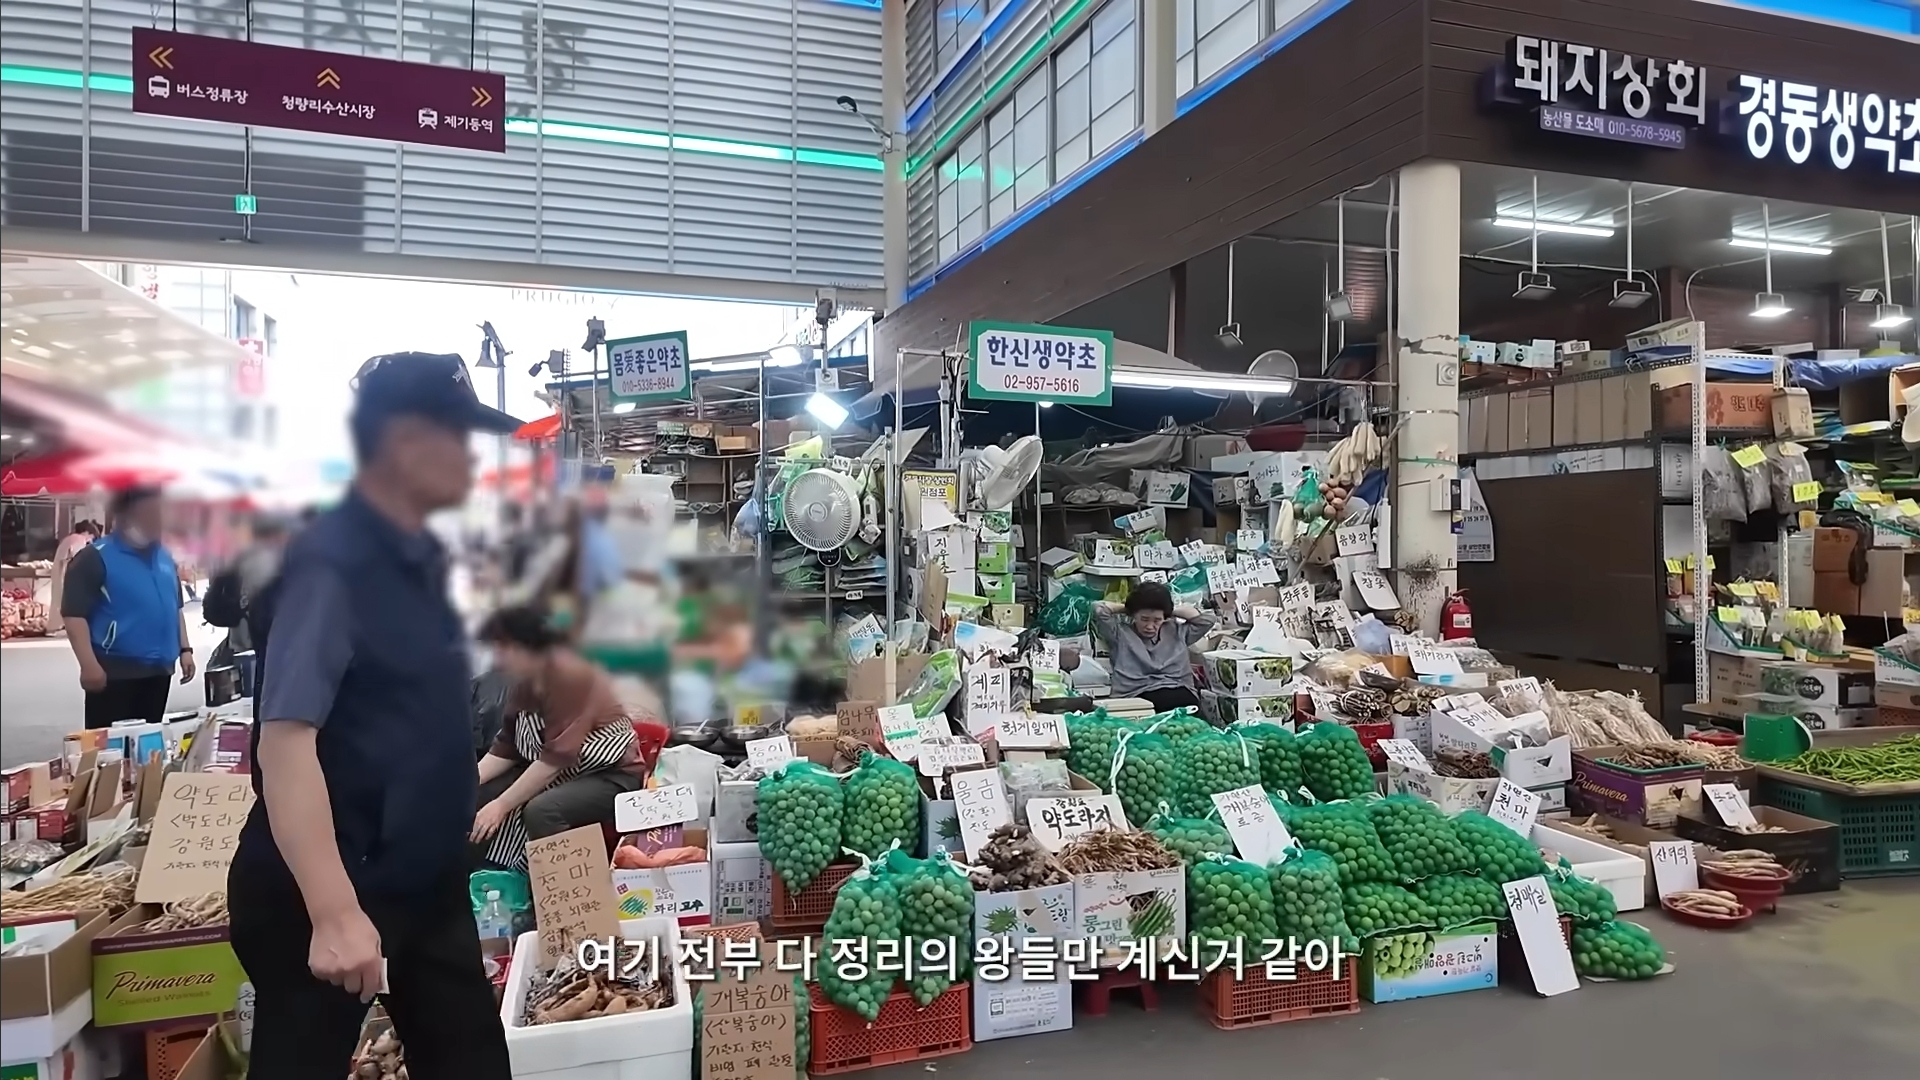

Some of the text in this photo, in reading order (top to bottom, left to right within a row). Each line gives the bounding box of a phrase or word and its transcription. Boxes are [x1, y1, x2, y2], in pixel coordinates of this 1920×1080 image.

[177, 83, 249, 105] 버스정류장
[1515, 35, 1706, 124] 돼지상회
[282, 95, 376, 120] 청량리수산시장
[444, 115, 494, 133] 제기동역
[1543, 110, 1682, 143] 농산물 도소매 010-5678-5945
[613, 347, 682, 375] 몸愛좋은약초
[987, 336, 1097, 371] 한신생약초
[622, 376, 675, 392] 010-5336-8944
[1004, 374, 1080, 393] 02-957-5616
[956, 779, 994, 806] 울금
[1573, 770, 1630, 803] Primavera
[1041, 809, 1112, 839] 약도라지
[537, 862, 594, 892] 천마
[106, 969, 217, 1000] Primavera
[711, 984, 791, 1013] 개복숭아
